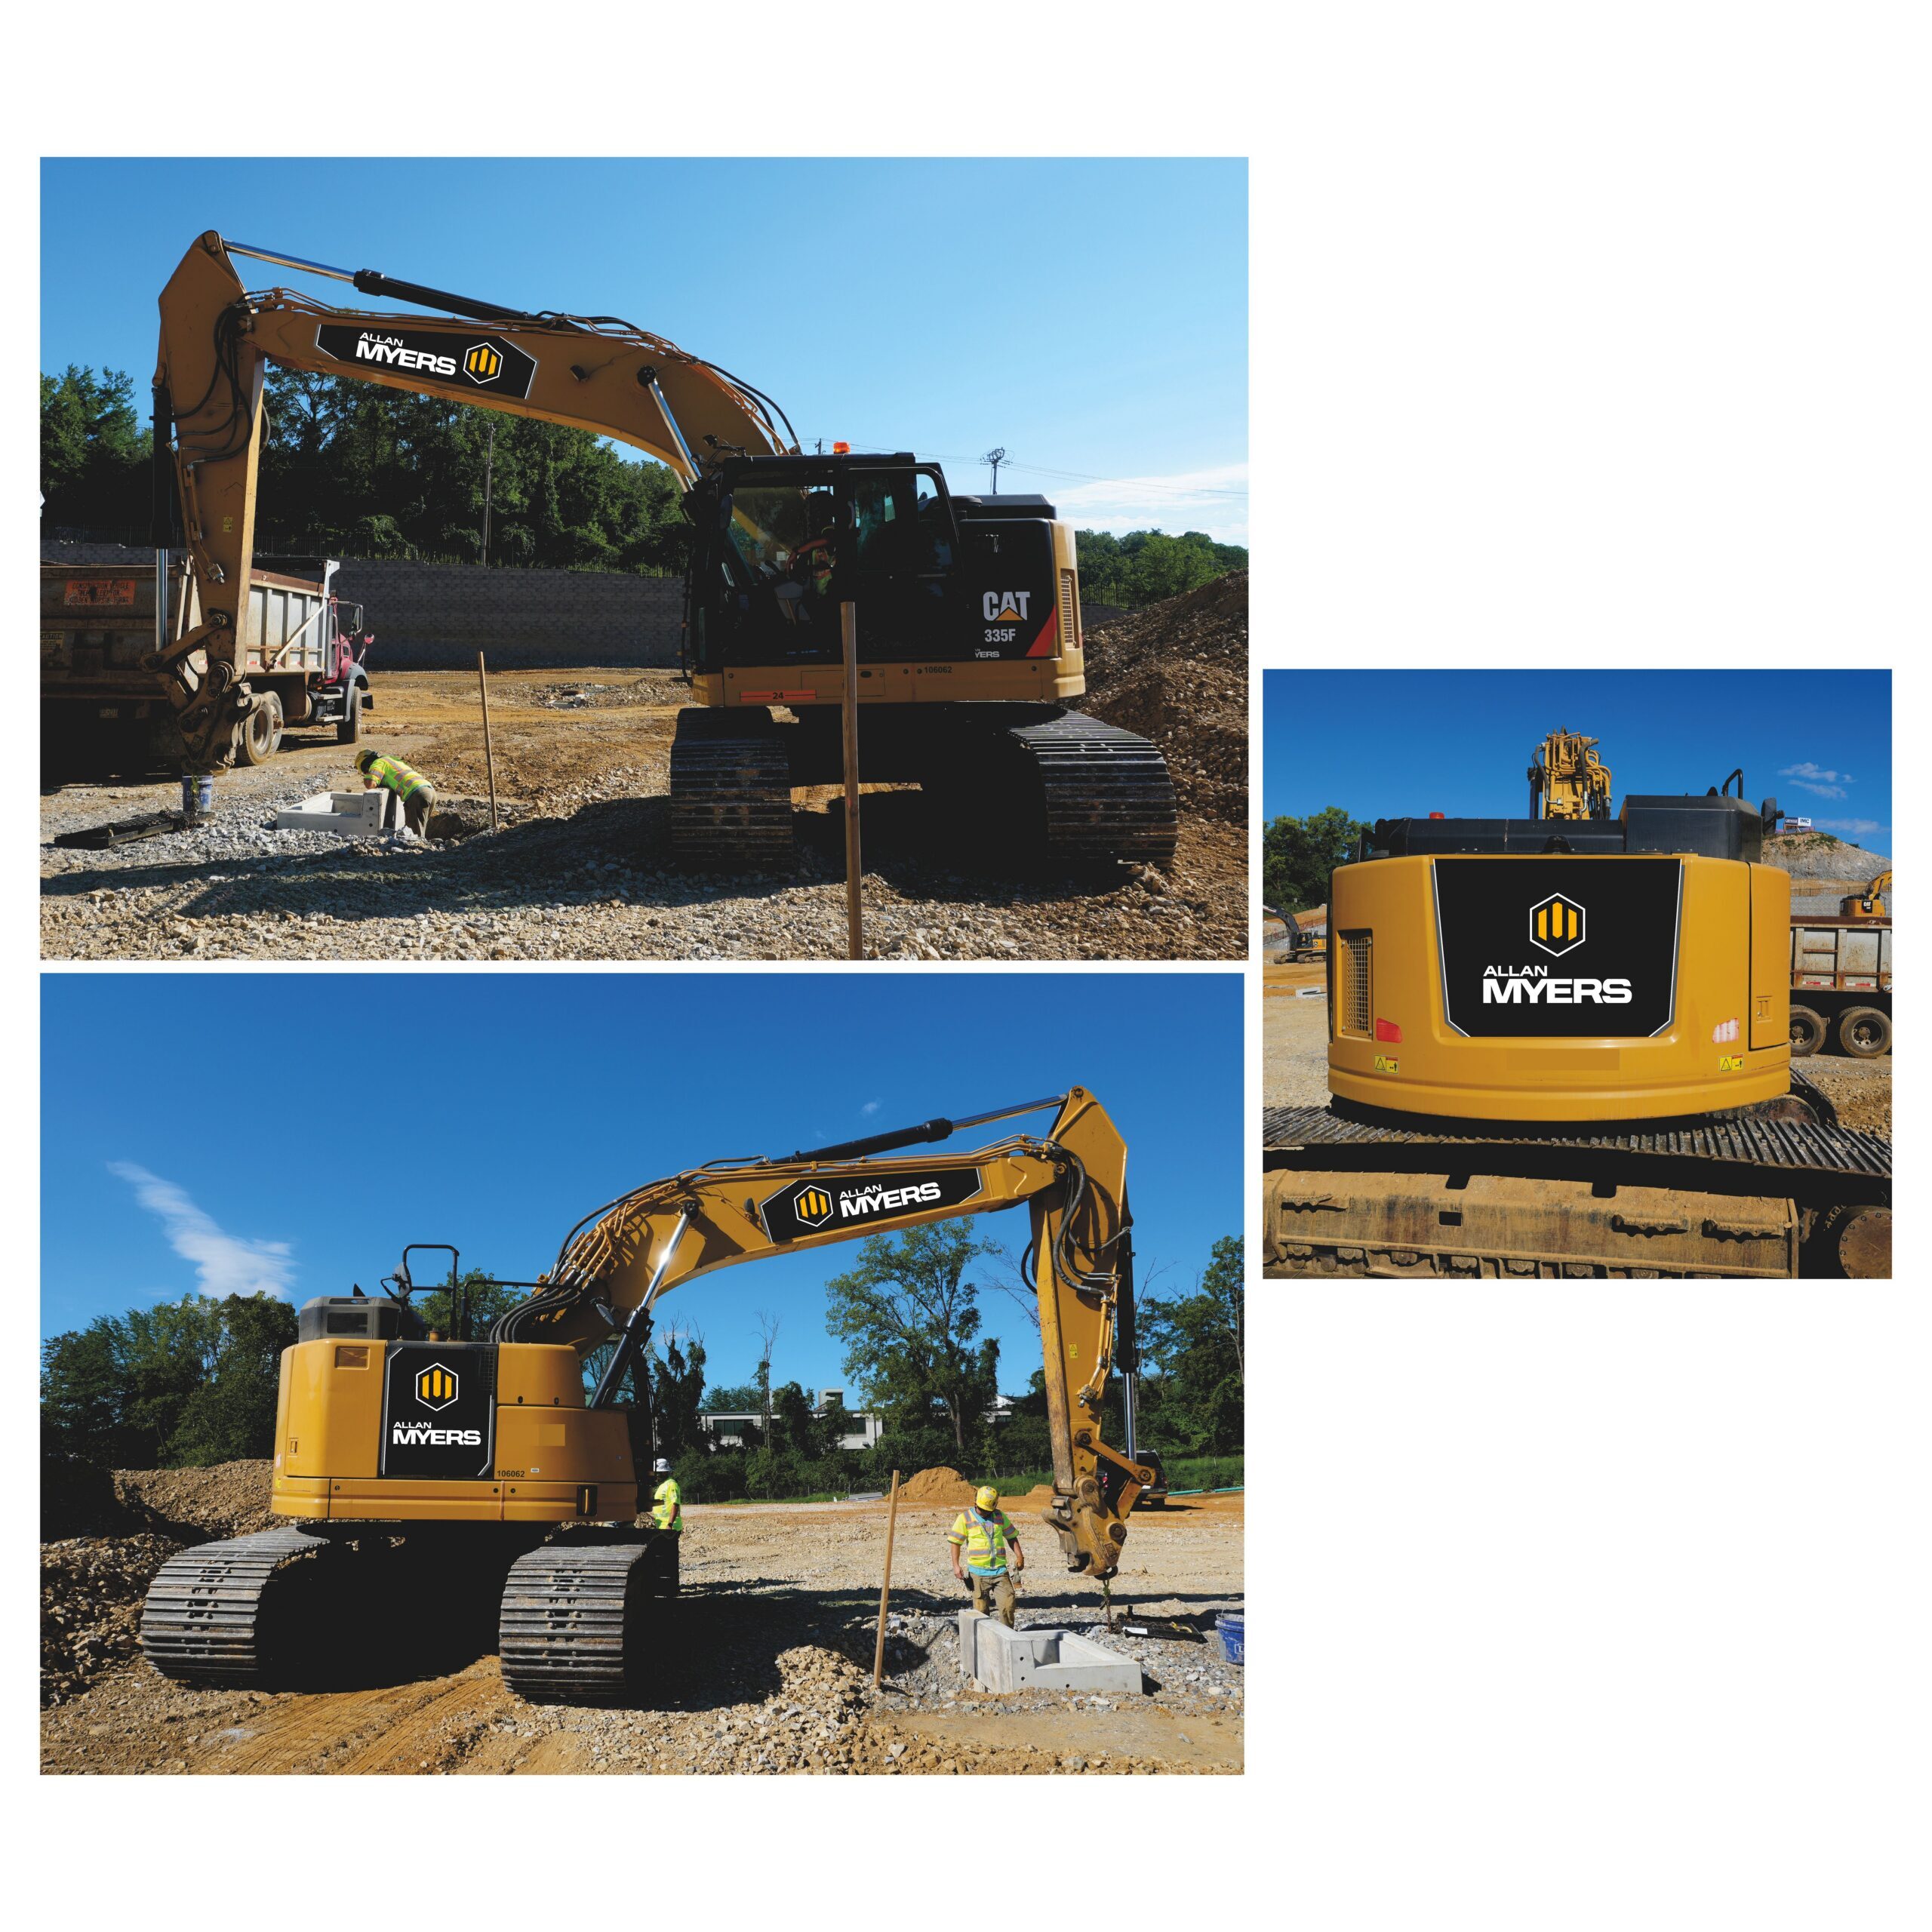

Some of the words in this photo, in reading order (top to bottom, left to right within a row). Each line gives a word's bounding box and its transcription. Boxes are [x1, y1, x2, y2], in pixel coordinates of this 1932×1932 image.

[359, 332, 404, 347] ALLAN
[355, 340, 457, 376] MYERS
[983, 591, 1031, 621] CAT
[984, 628, 1016, 642] 335F
[924, 666, 953, 674] 106062
[772, 691, 784, 700] 24
[1483, 965, 1548, 977] ALLAN
[1482, 978, 1633, 1004] MYERS
[839, 1183, 882, 1200] ALLAN
[839, 1182, 941, 1218] MYERS
[392, 1429, 481, 1445] MYERS
